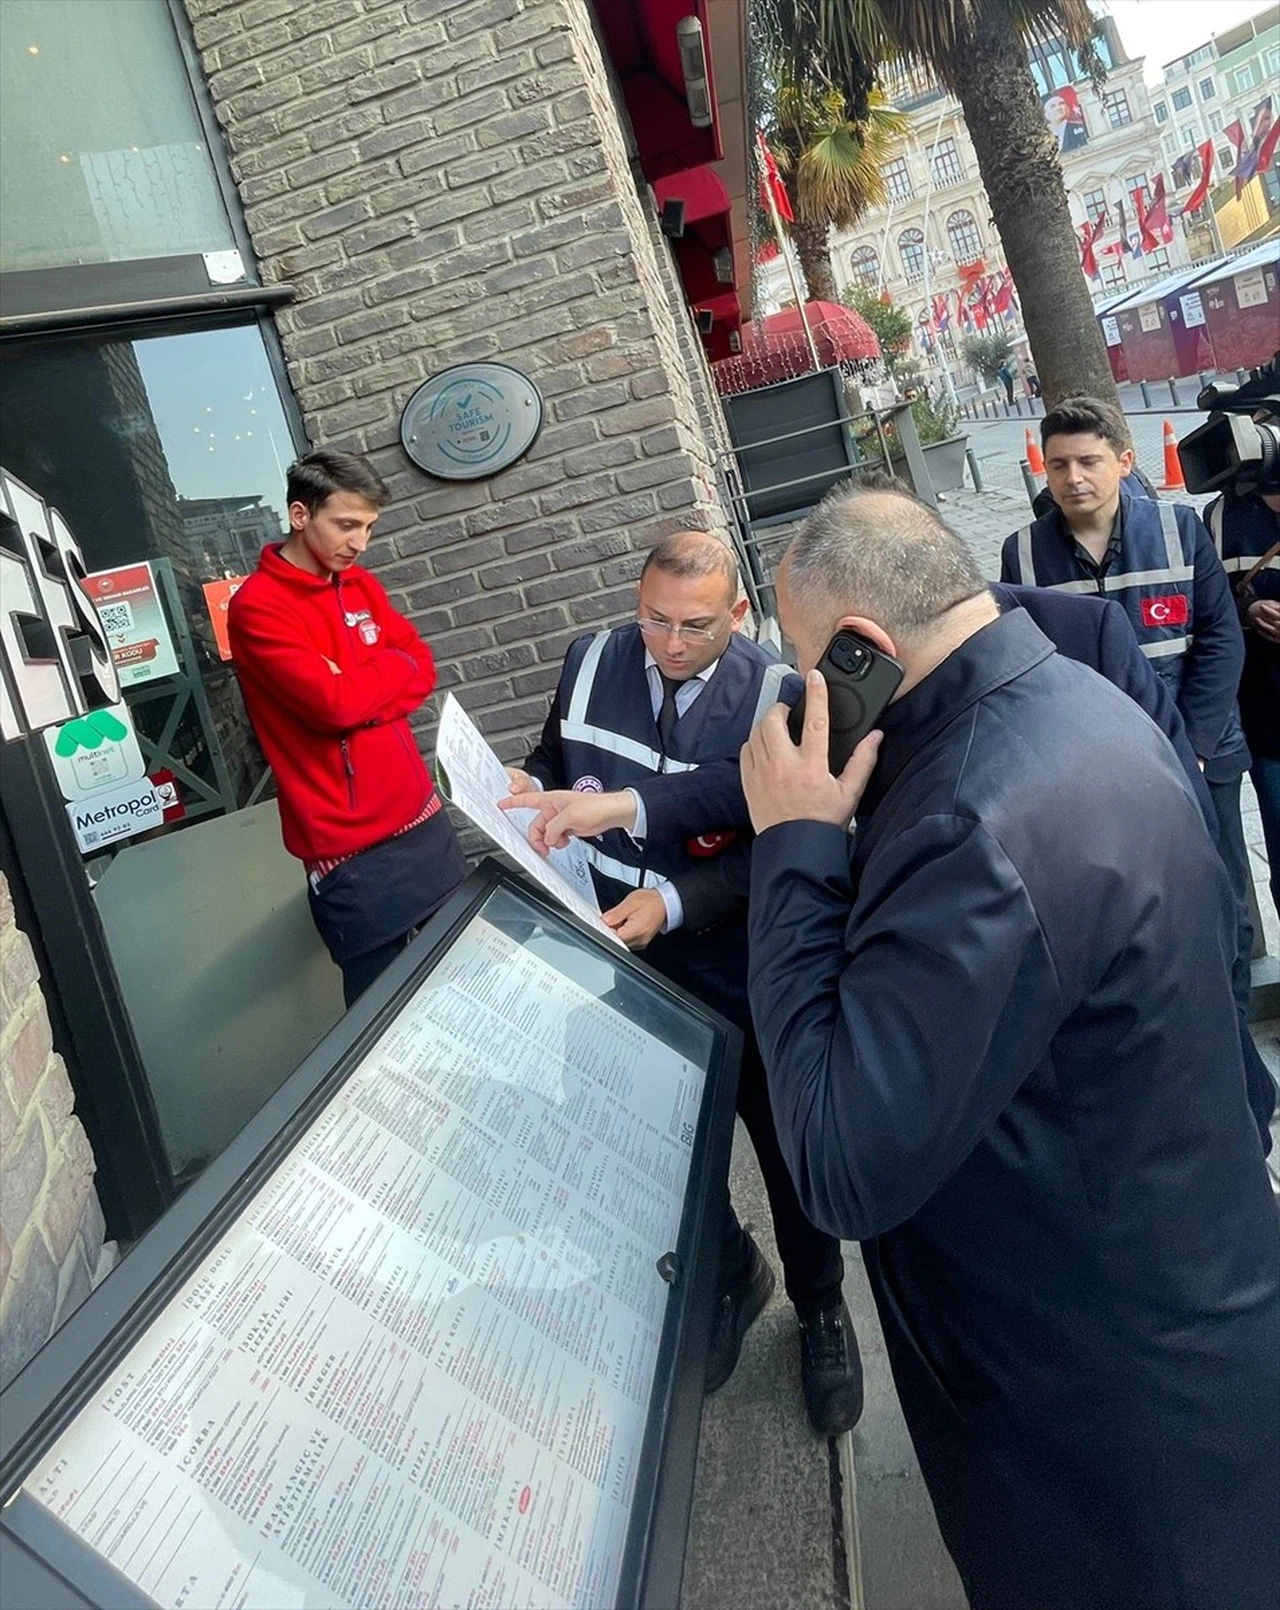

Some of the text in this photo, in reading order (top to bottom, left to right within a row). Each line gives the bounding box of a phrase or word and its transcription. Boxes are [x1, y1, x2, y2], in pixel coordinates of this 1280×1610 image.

[449, 412, 494, 433] TOURISM
[455, 407, 482, 420] SAFE
[78, 746, 115, 763] multinet
[76, 790, 157, 830] Metropol
[135, 804, 159, 818] Card
[680, 1119, 694, 1147] BIG
[371, 1180, 388, 1204] BALIK
[417, 1211, 434, 1238] VEGAN
[185, 1246, 232, 1304] DOLU DOLU
[321, 1245, 343, 1276] TAVUK
[372, 1263, 403, 1315] SCHNITZEL
[241, 1309, 269, 1348] SOKAK
[248, 1289, 293, 1353] LEZZETLERİ
[436, 1348, 446, 1364] ET
[448, 1304, 465, 1337] KÖFTE
[107, 1370, 136, 1405] TOST
[307, 1352, 336, 1399] BURGER
[182, 1417, 216, 1466] ÇORBA
[410, 1438, 430, 1477] PİZZA
[37, 1457, 68, 1495] ALTI
[264, 1426, 323, 1531] BAŞLANGIÇ VE
[496, 1477, 520, 1544] MAKARNA
